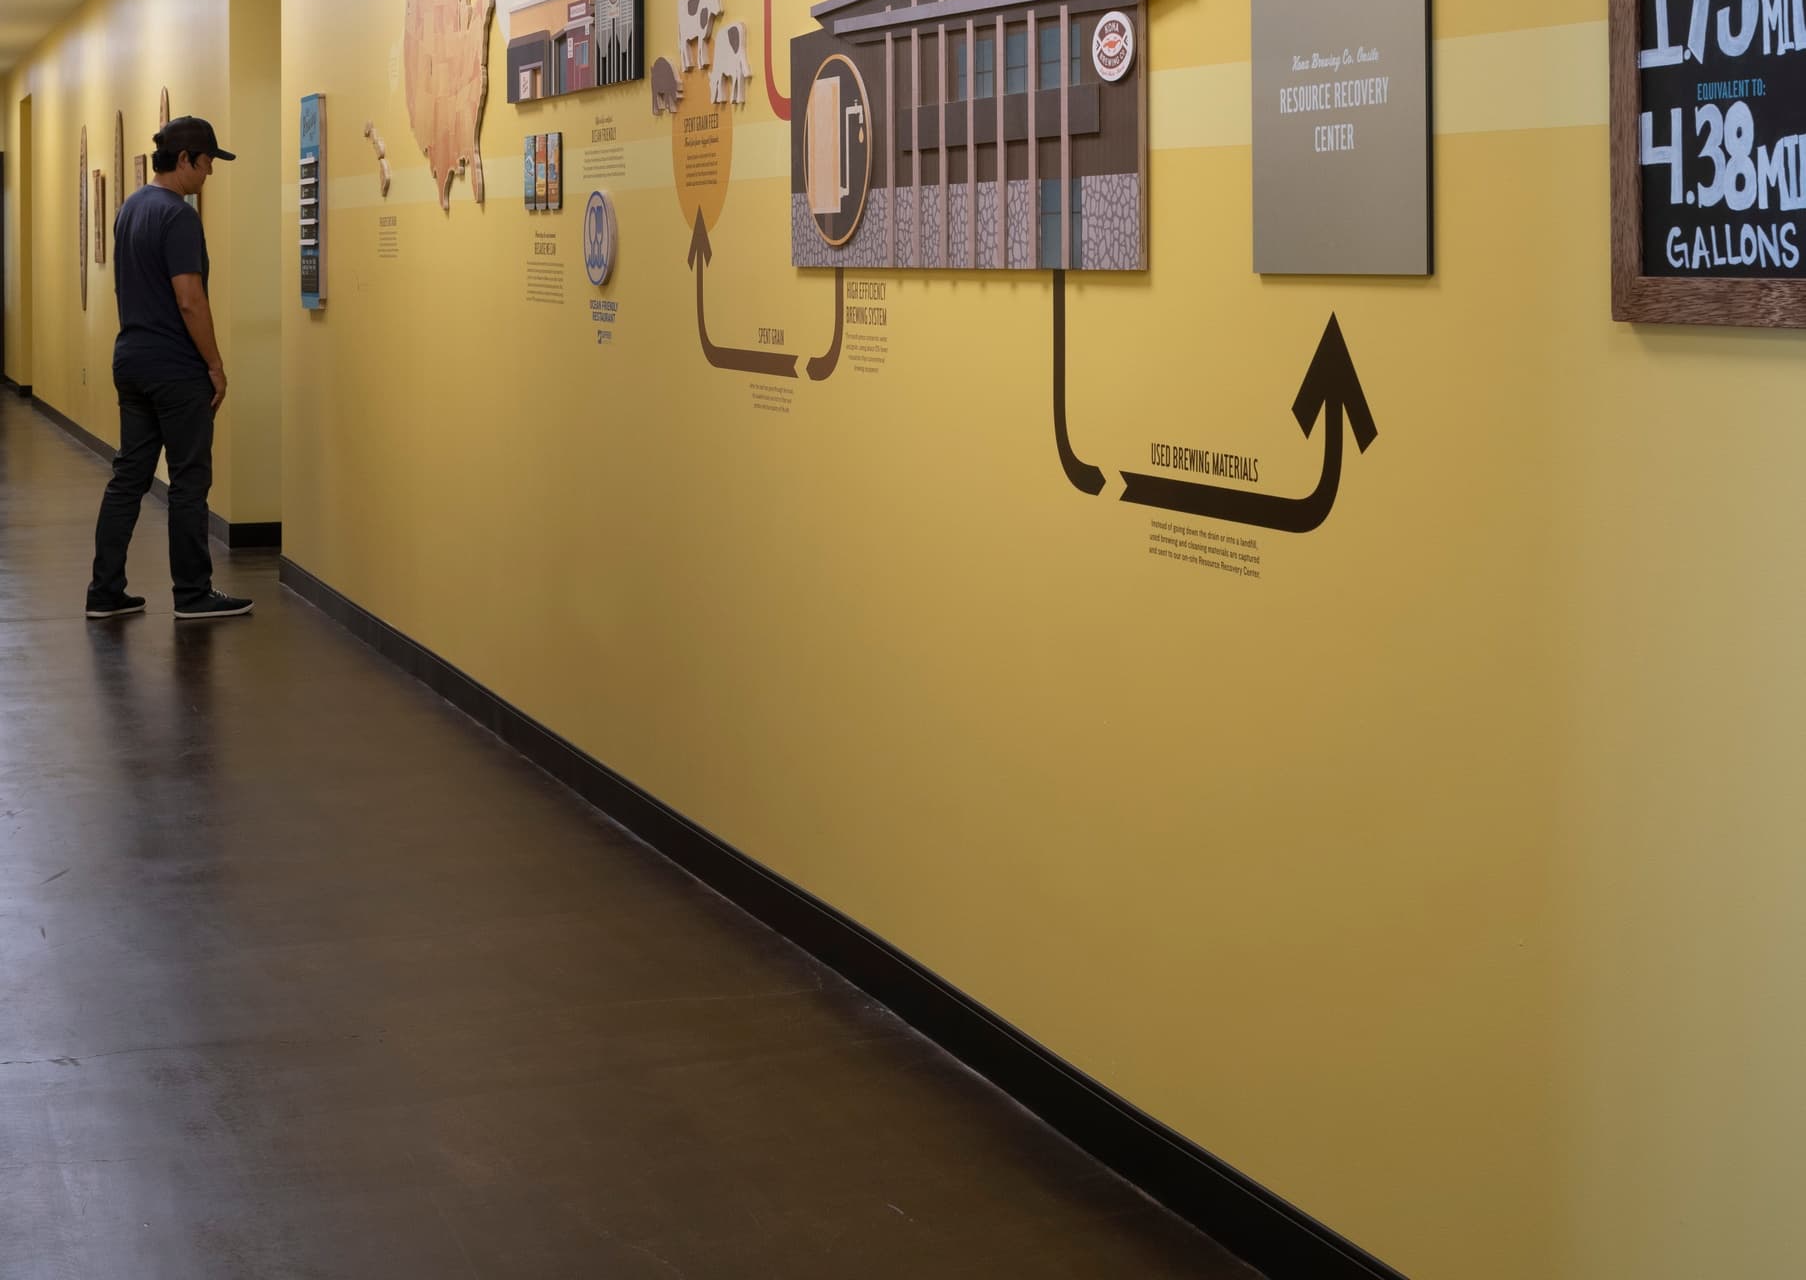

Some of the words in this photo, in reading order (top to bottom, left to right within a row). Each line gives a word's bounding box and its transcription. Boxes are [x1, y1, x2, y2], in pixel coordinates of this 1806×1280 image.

[1311, 53, 1341, 72] Brewing
[1280, 83, 1331, 114] RESOURCE
[1334, 76, 1389, 109] RECOVERY
[1697, 80, 1750, 101] EQUIVALENT
[1751, 78, 1766, 97] TO:
[1315, 123, 1354, 152] CENTER
[1639, 100, 1757, 211] 4.38
[1666, 222, 1799, 269] GALLONS
[847, 282, 859, 300] HIGH
[859, 282, 887, 301] EFFICIENCY
[846, 306, 868, 325] BREWING
[868, 307, 887, 326] SYSTEM
[758, 328, 771, 345] SPENT
[772, 329, 785, 346] GRAIN
[1151, 442, 1170, 467] USED
[1173, 446, 1209, 474] BREWING
[1212, 452, 1259, 482] MATERIALS
[1199, 528, 1207, 538] the
[1198, 556, 1220, 569] Resource
[1220, 561, 1243, 576] Recovery
